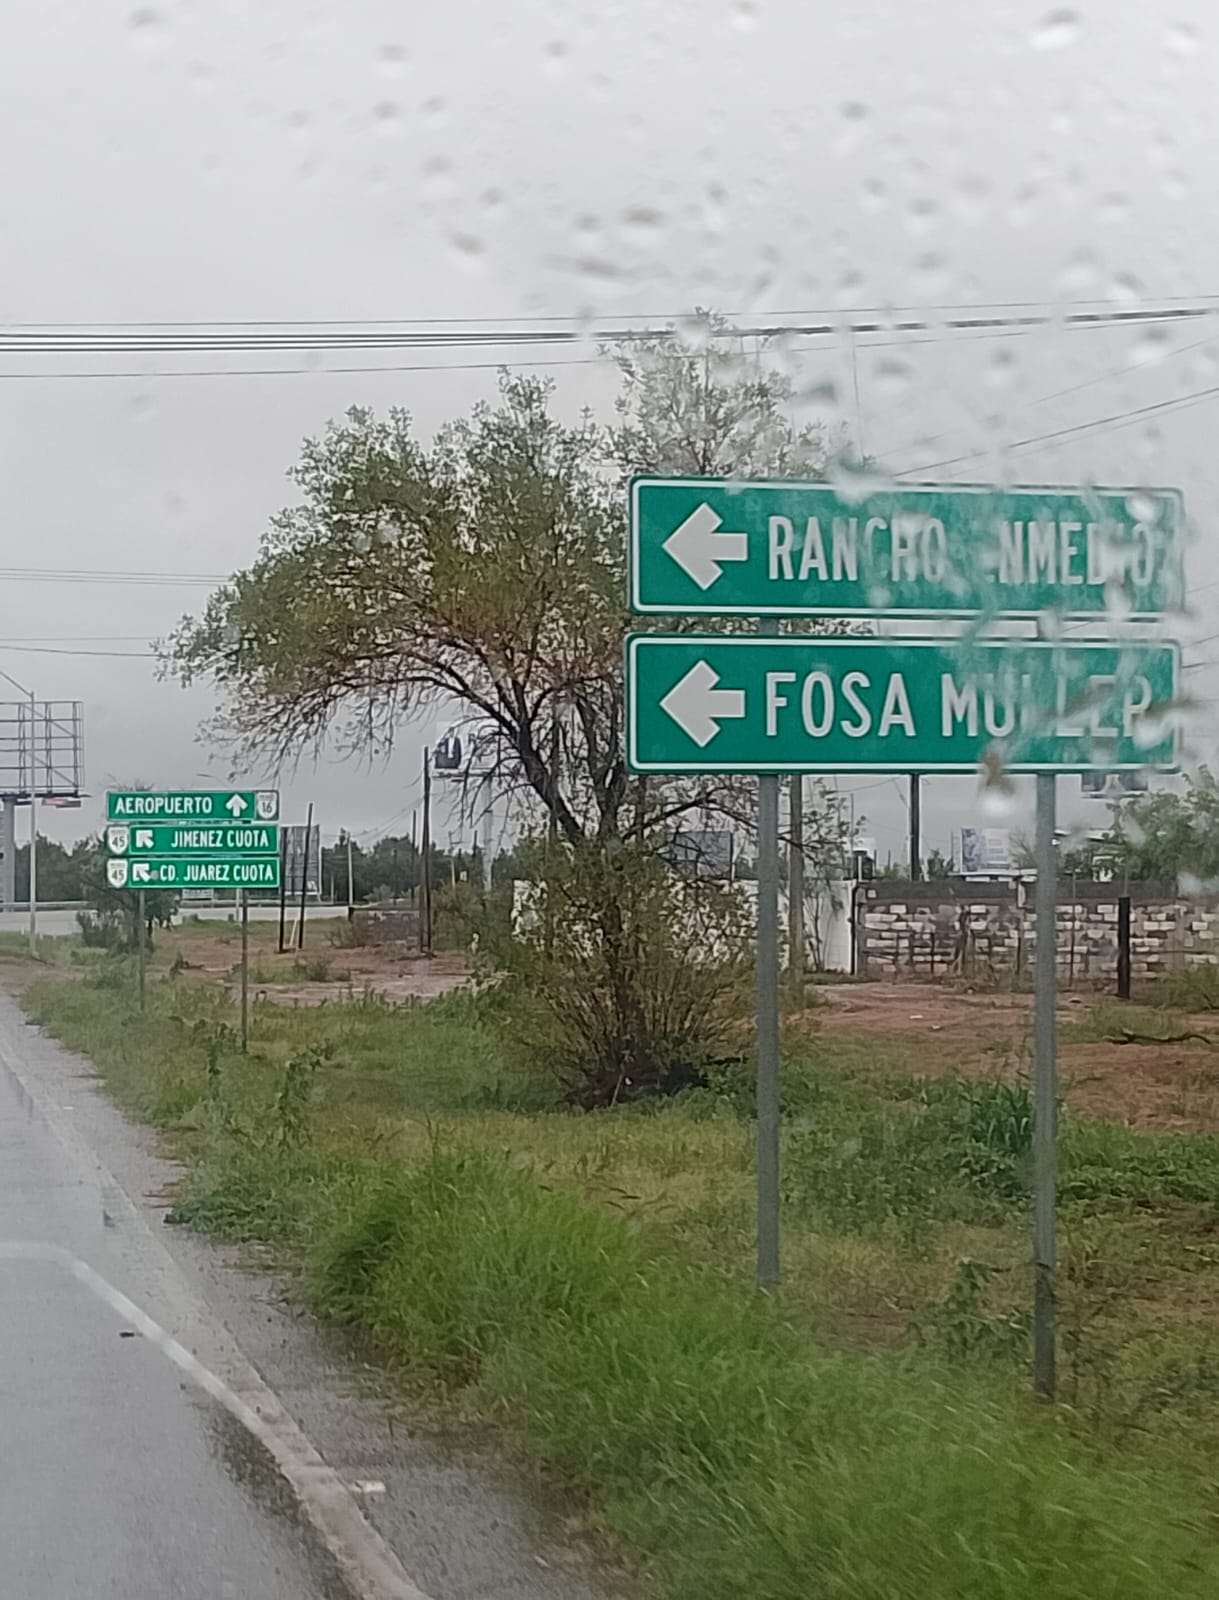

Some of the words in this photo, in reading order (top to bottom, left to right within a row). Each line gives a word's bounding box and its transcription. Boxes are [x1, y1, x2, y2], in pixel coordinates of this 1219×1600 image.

[768, 515, 947, 582] RANCHO
[978, 521, 1153, 586] NMEDO
[766, 671, 917, 738] FOSA
[115, 796, 213, 814] AEROPUERTO
[261, 801, 273, 813] 16
[112, 836, 125, 848] 45
[171, 829, 223, 848] JIMENEZ
[227, 829, 269, 848] CUOTA
[111, 869, 125, 881] 45
[159, 864, 180, 882] CD.
[183, 864, 230, 882] JUAREZ
[233, 864, 274, 882] CUOTA
